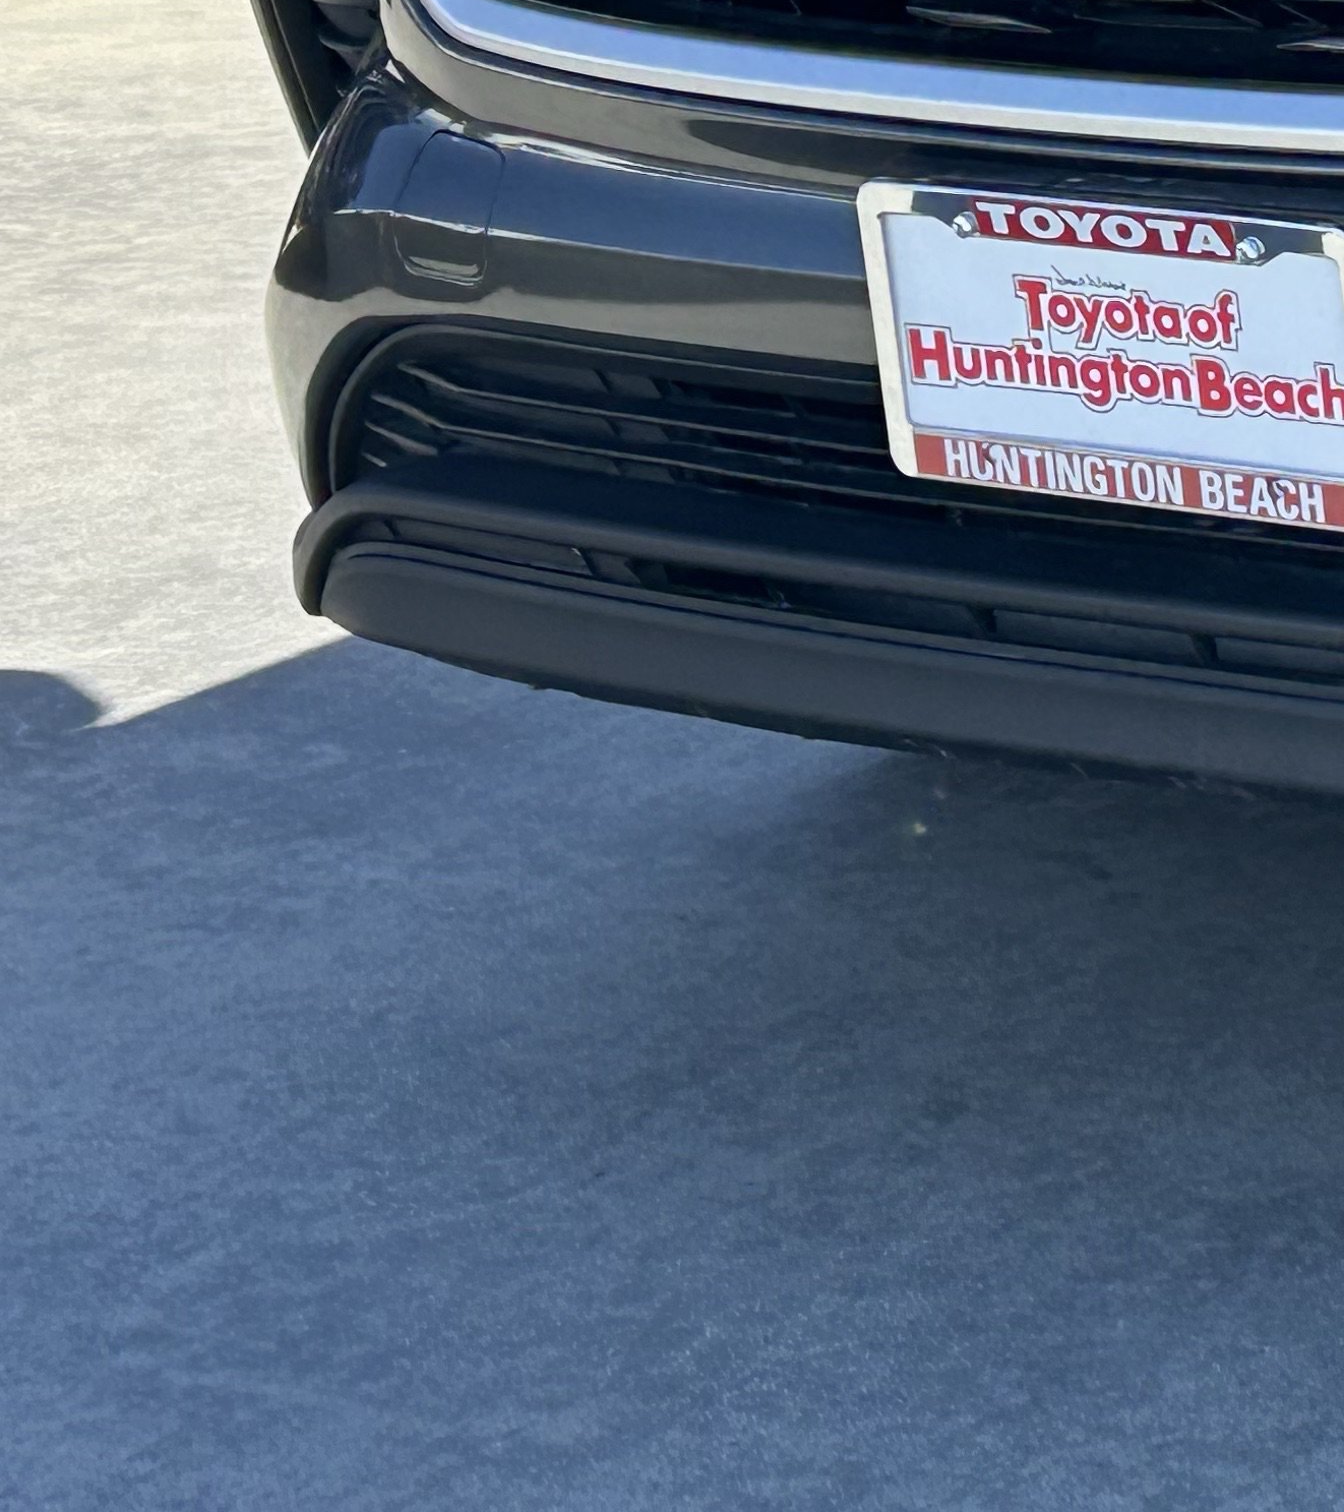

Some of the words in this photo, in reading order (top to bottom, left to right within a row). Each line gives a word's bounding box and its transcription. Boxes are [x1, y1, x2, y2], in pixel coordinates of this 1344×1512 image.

[975, 201, 1233, 258] TOYOTA
[907, 328, 1192, 407] Huntington
[943, 438, 1184, 506] HUNTINGTON
[1199, 470, 1326, 524] BEACH
